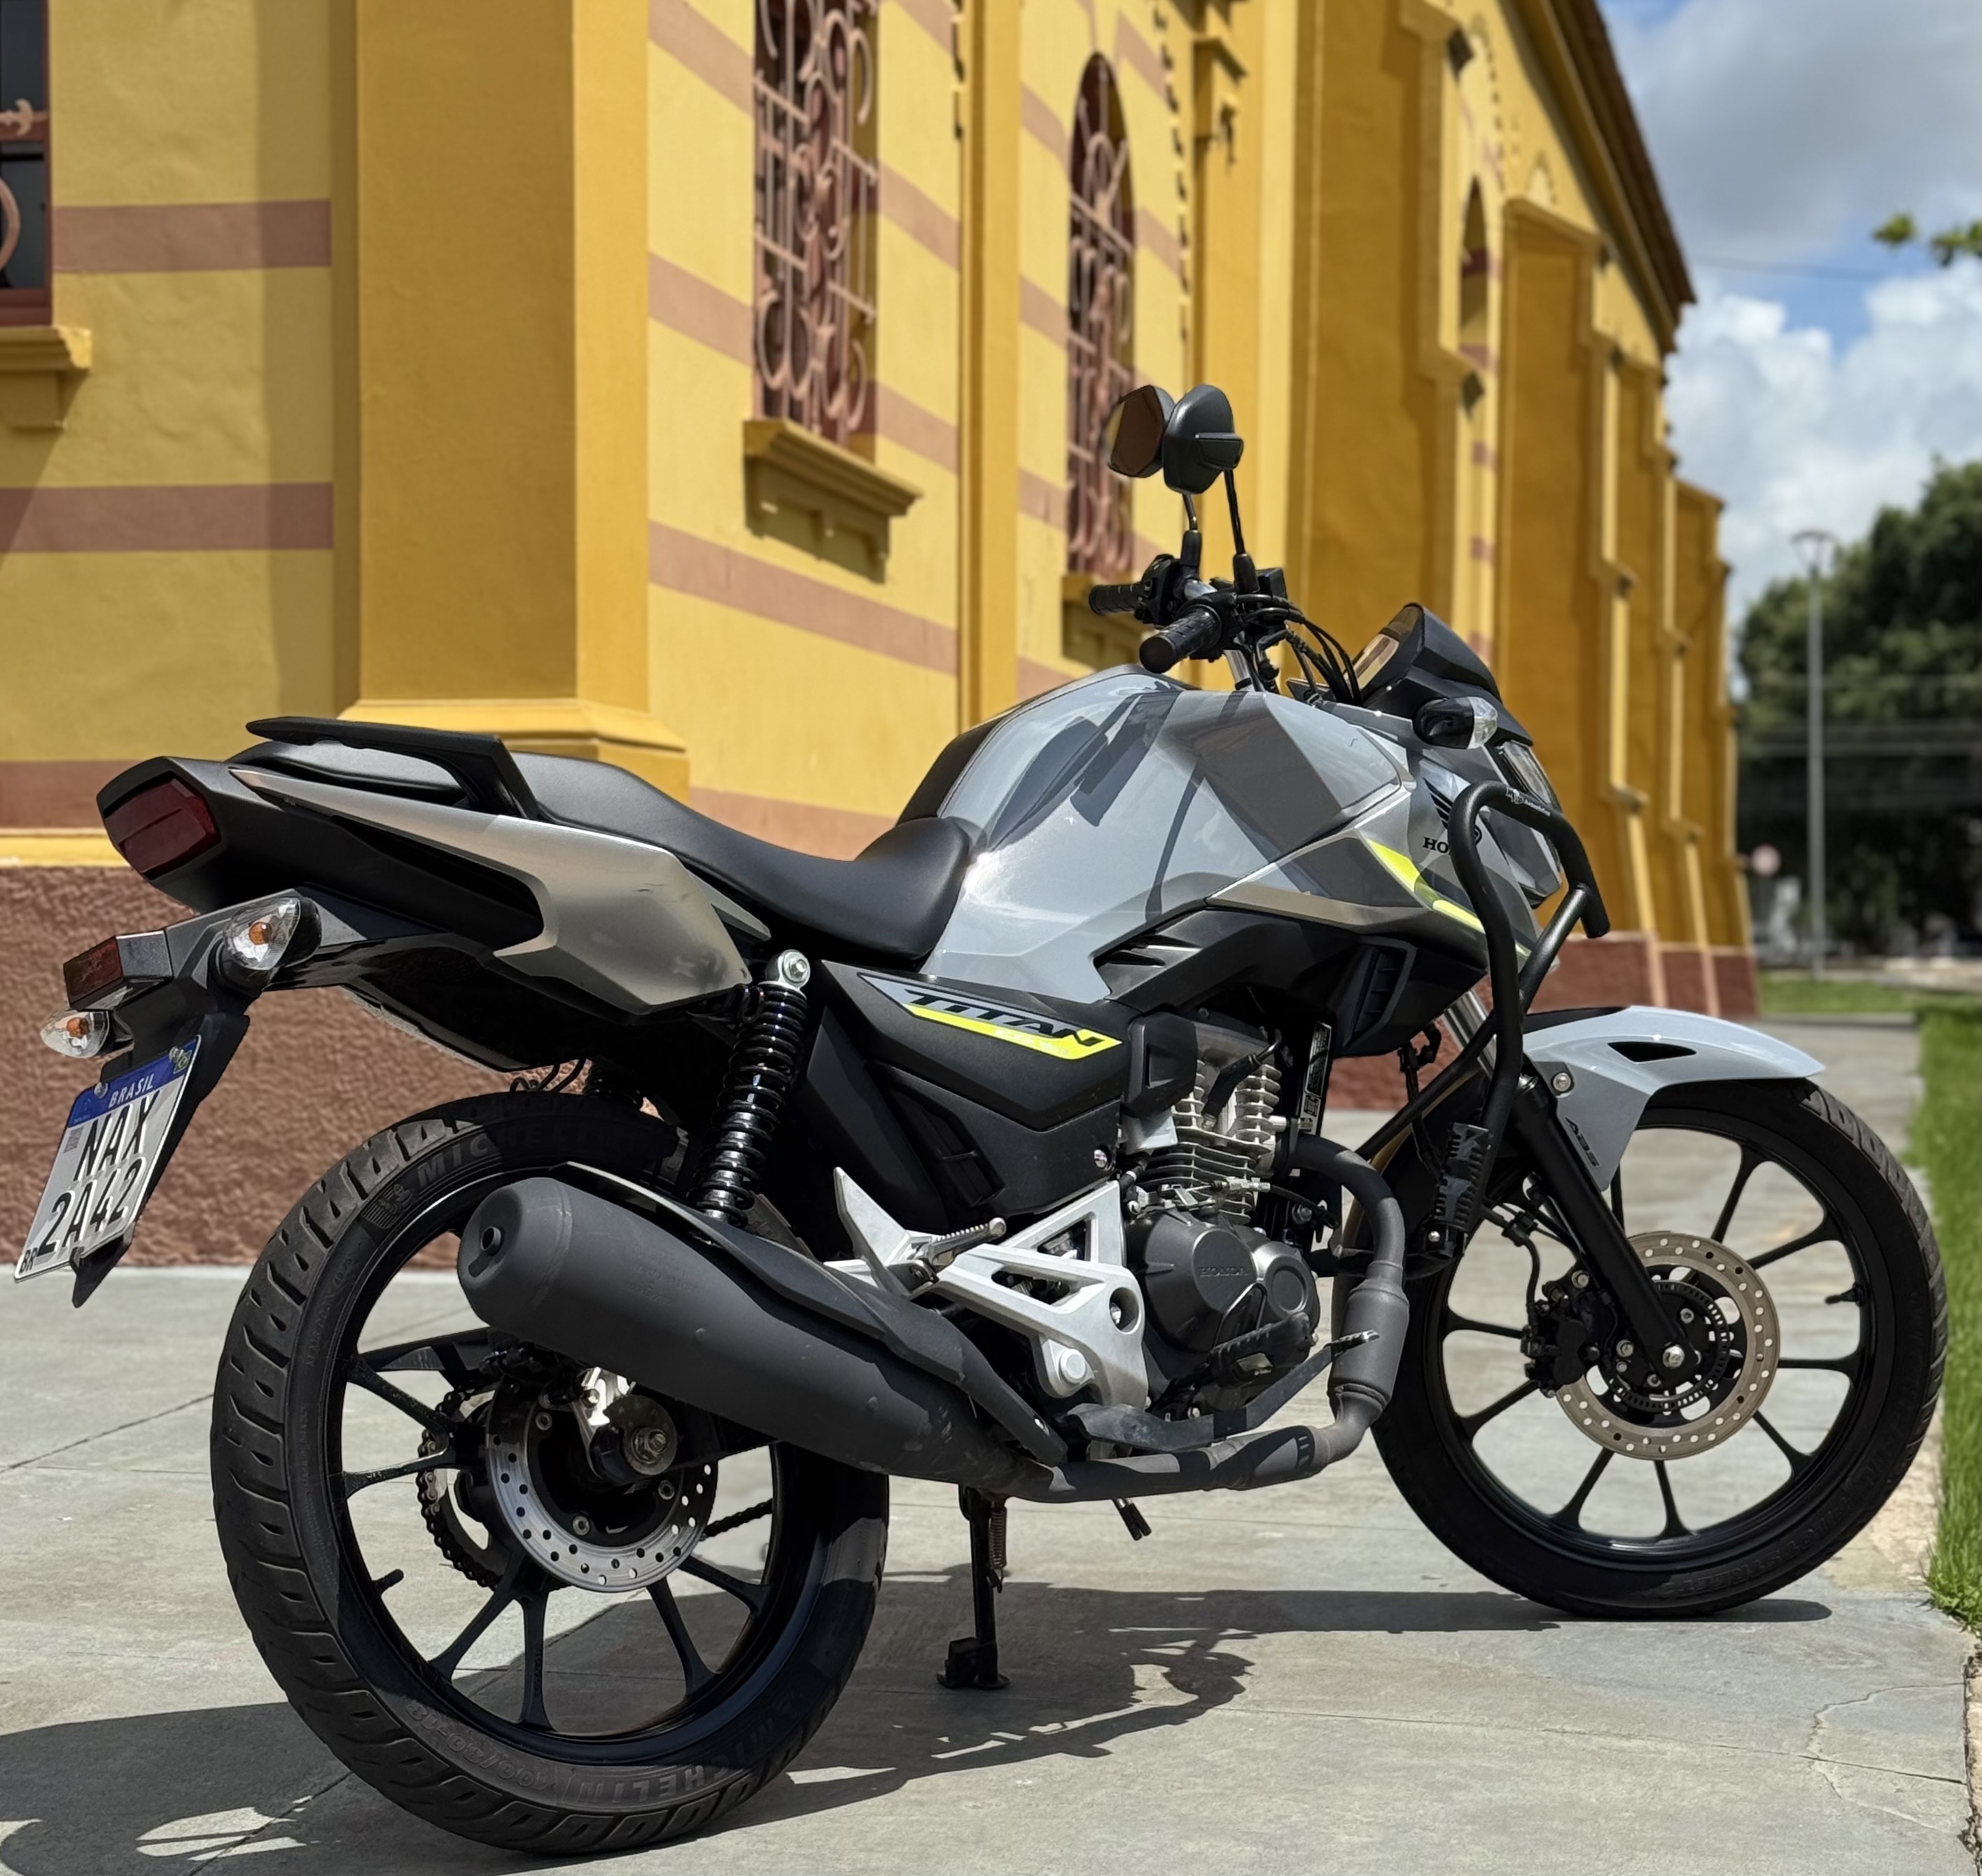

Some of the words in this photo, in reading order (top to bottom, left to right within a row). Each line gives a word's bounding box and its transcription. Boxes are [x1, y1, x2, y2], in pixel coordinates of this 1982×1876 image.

[904, 988, 1105, 1047] TITAN
[108, 1073, 154, 1109] BRASIL
[74, 1090, 160, 1182] NAX
[1565, 1117, 1600, 1167] ABS
[37, 1157, 145, 1256] 2A42
[20, 1247, 38, 1274] BR
[1198, 1265, 1250, 1278] HONDA
